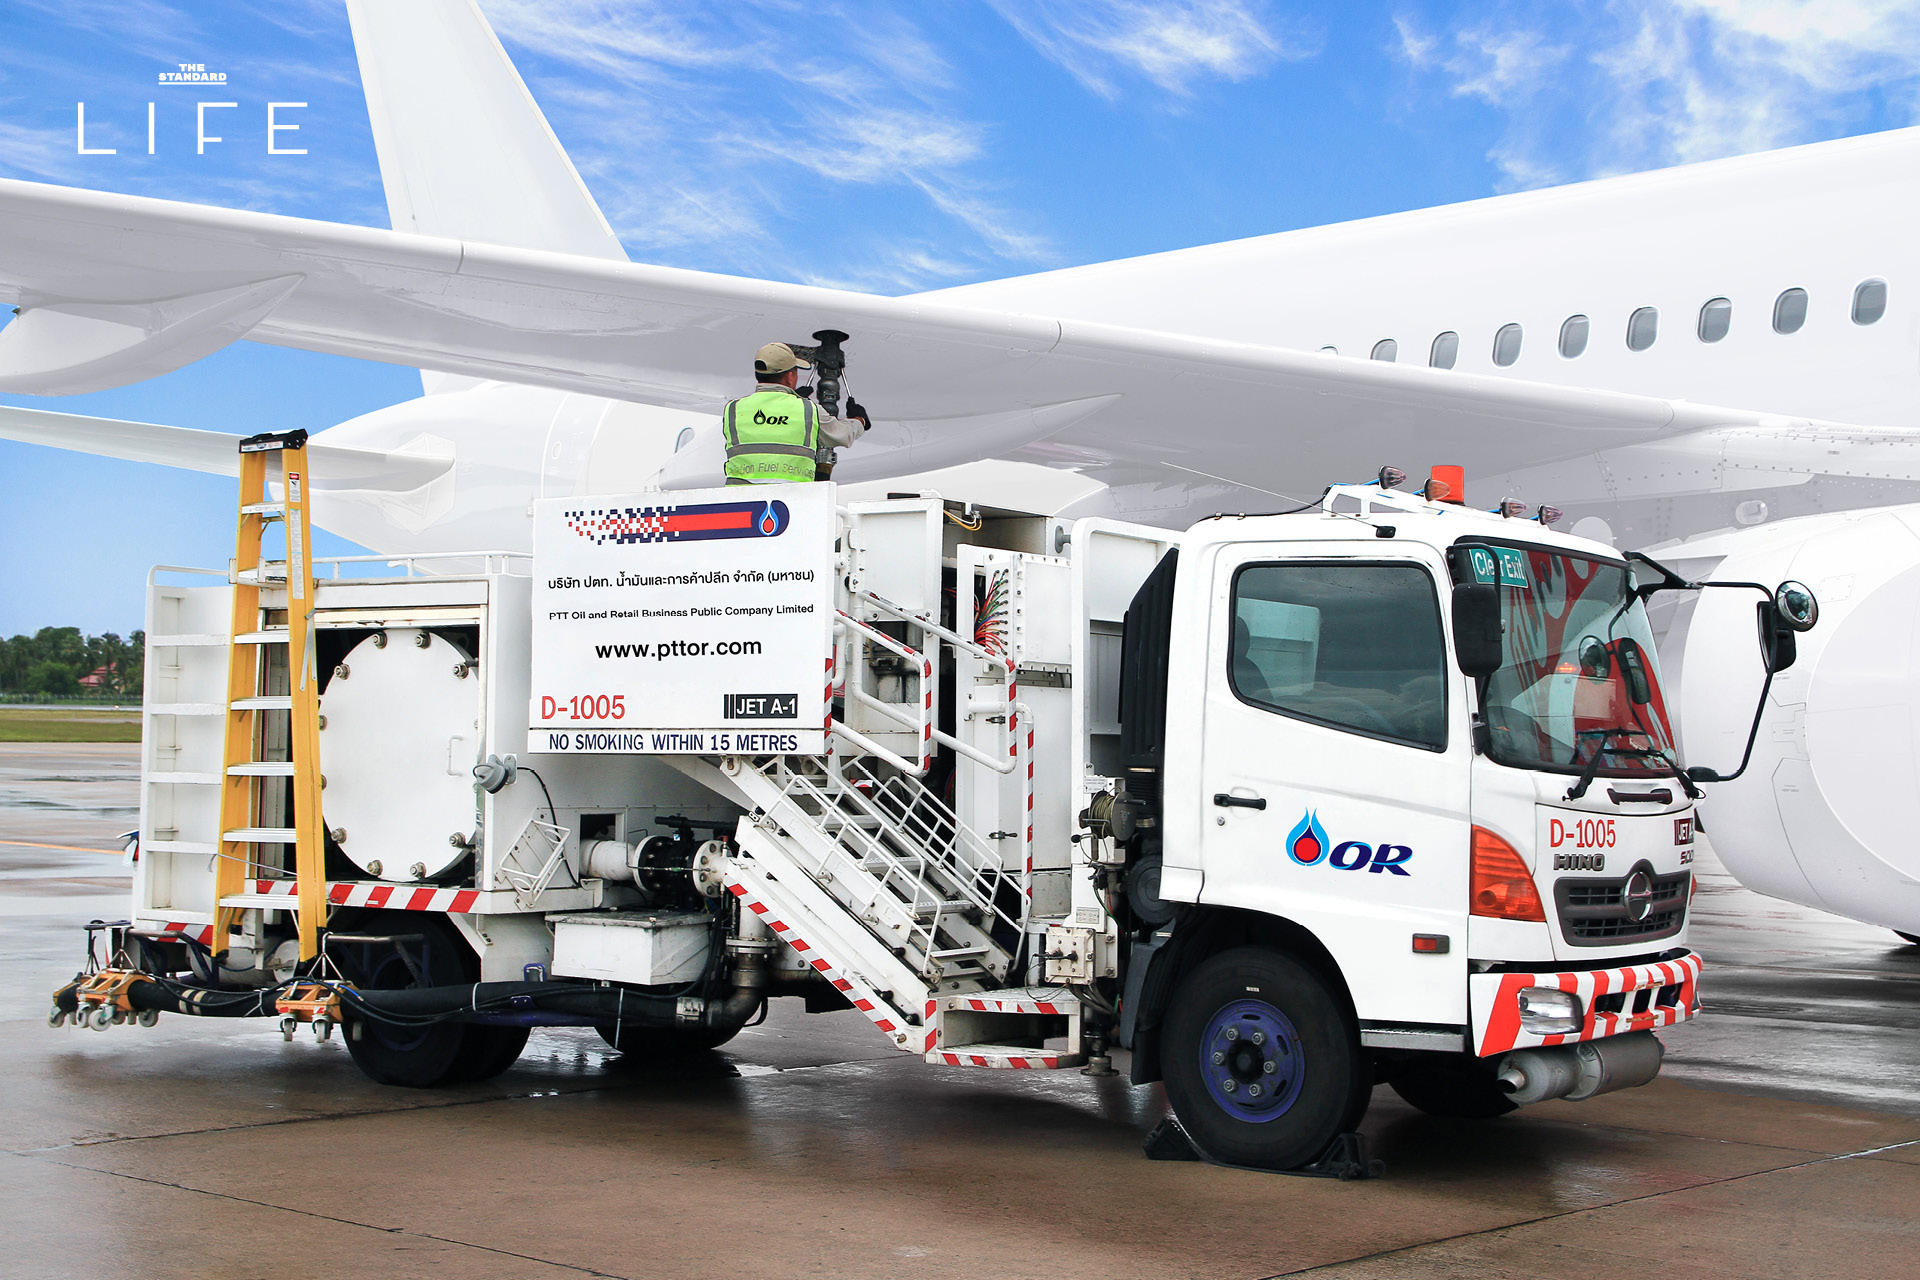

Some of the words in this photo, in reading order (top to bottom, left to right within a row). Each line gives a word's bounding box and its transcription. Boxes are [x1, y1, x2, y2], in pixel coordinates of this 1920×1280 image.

[766, 415, 789, 425] OR
[757, 462, 778, 473] Fuel
[1474, 551, 1505, 577] Cler
[1504, 554, 1525, 580] Exit
[548, 574, 580, 590] บริษัท
[584, 575, 612, 588] ปตท.
[616, 571, 729, 587] น้ำมันและการค้าปลีก
[733, 570, 764, 583] จำกัด
[768, 569, 815, 584] (มหาชน)
[549, 612, 569, 621] PTT
[572, 610, 586, 620] Oil
[588, 610, 607, 619] and
[610, 609, 639, 619] Retail
[642, 608, 688, 618] Business
[691, 607, 722, 617] Public
[725, 606, 773, 618] Company
[776, 604, 814, 614] Limited
[595, 640, 762, 661] www.pttor.com
[541, 694, 625, 720] D-1005
[736, 698, 767, 715] JET
[770, 697, 796, 715] A-1
[549, 733, 569, 751] NO
[575, 733, 644, 751] SMOKING
[651, 733, 704, 751] WITHIN
[711, 733, 730, 751] 15
[736, 734, 798, 752] METRES
[1550, 818, 1616, 848] D-1005
[1678, 823, 1689, 841] JET
[1328, 841, 1413, 877] OR
[1553, 853, 1605, 872] HINO
